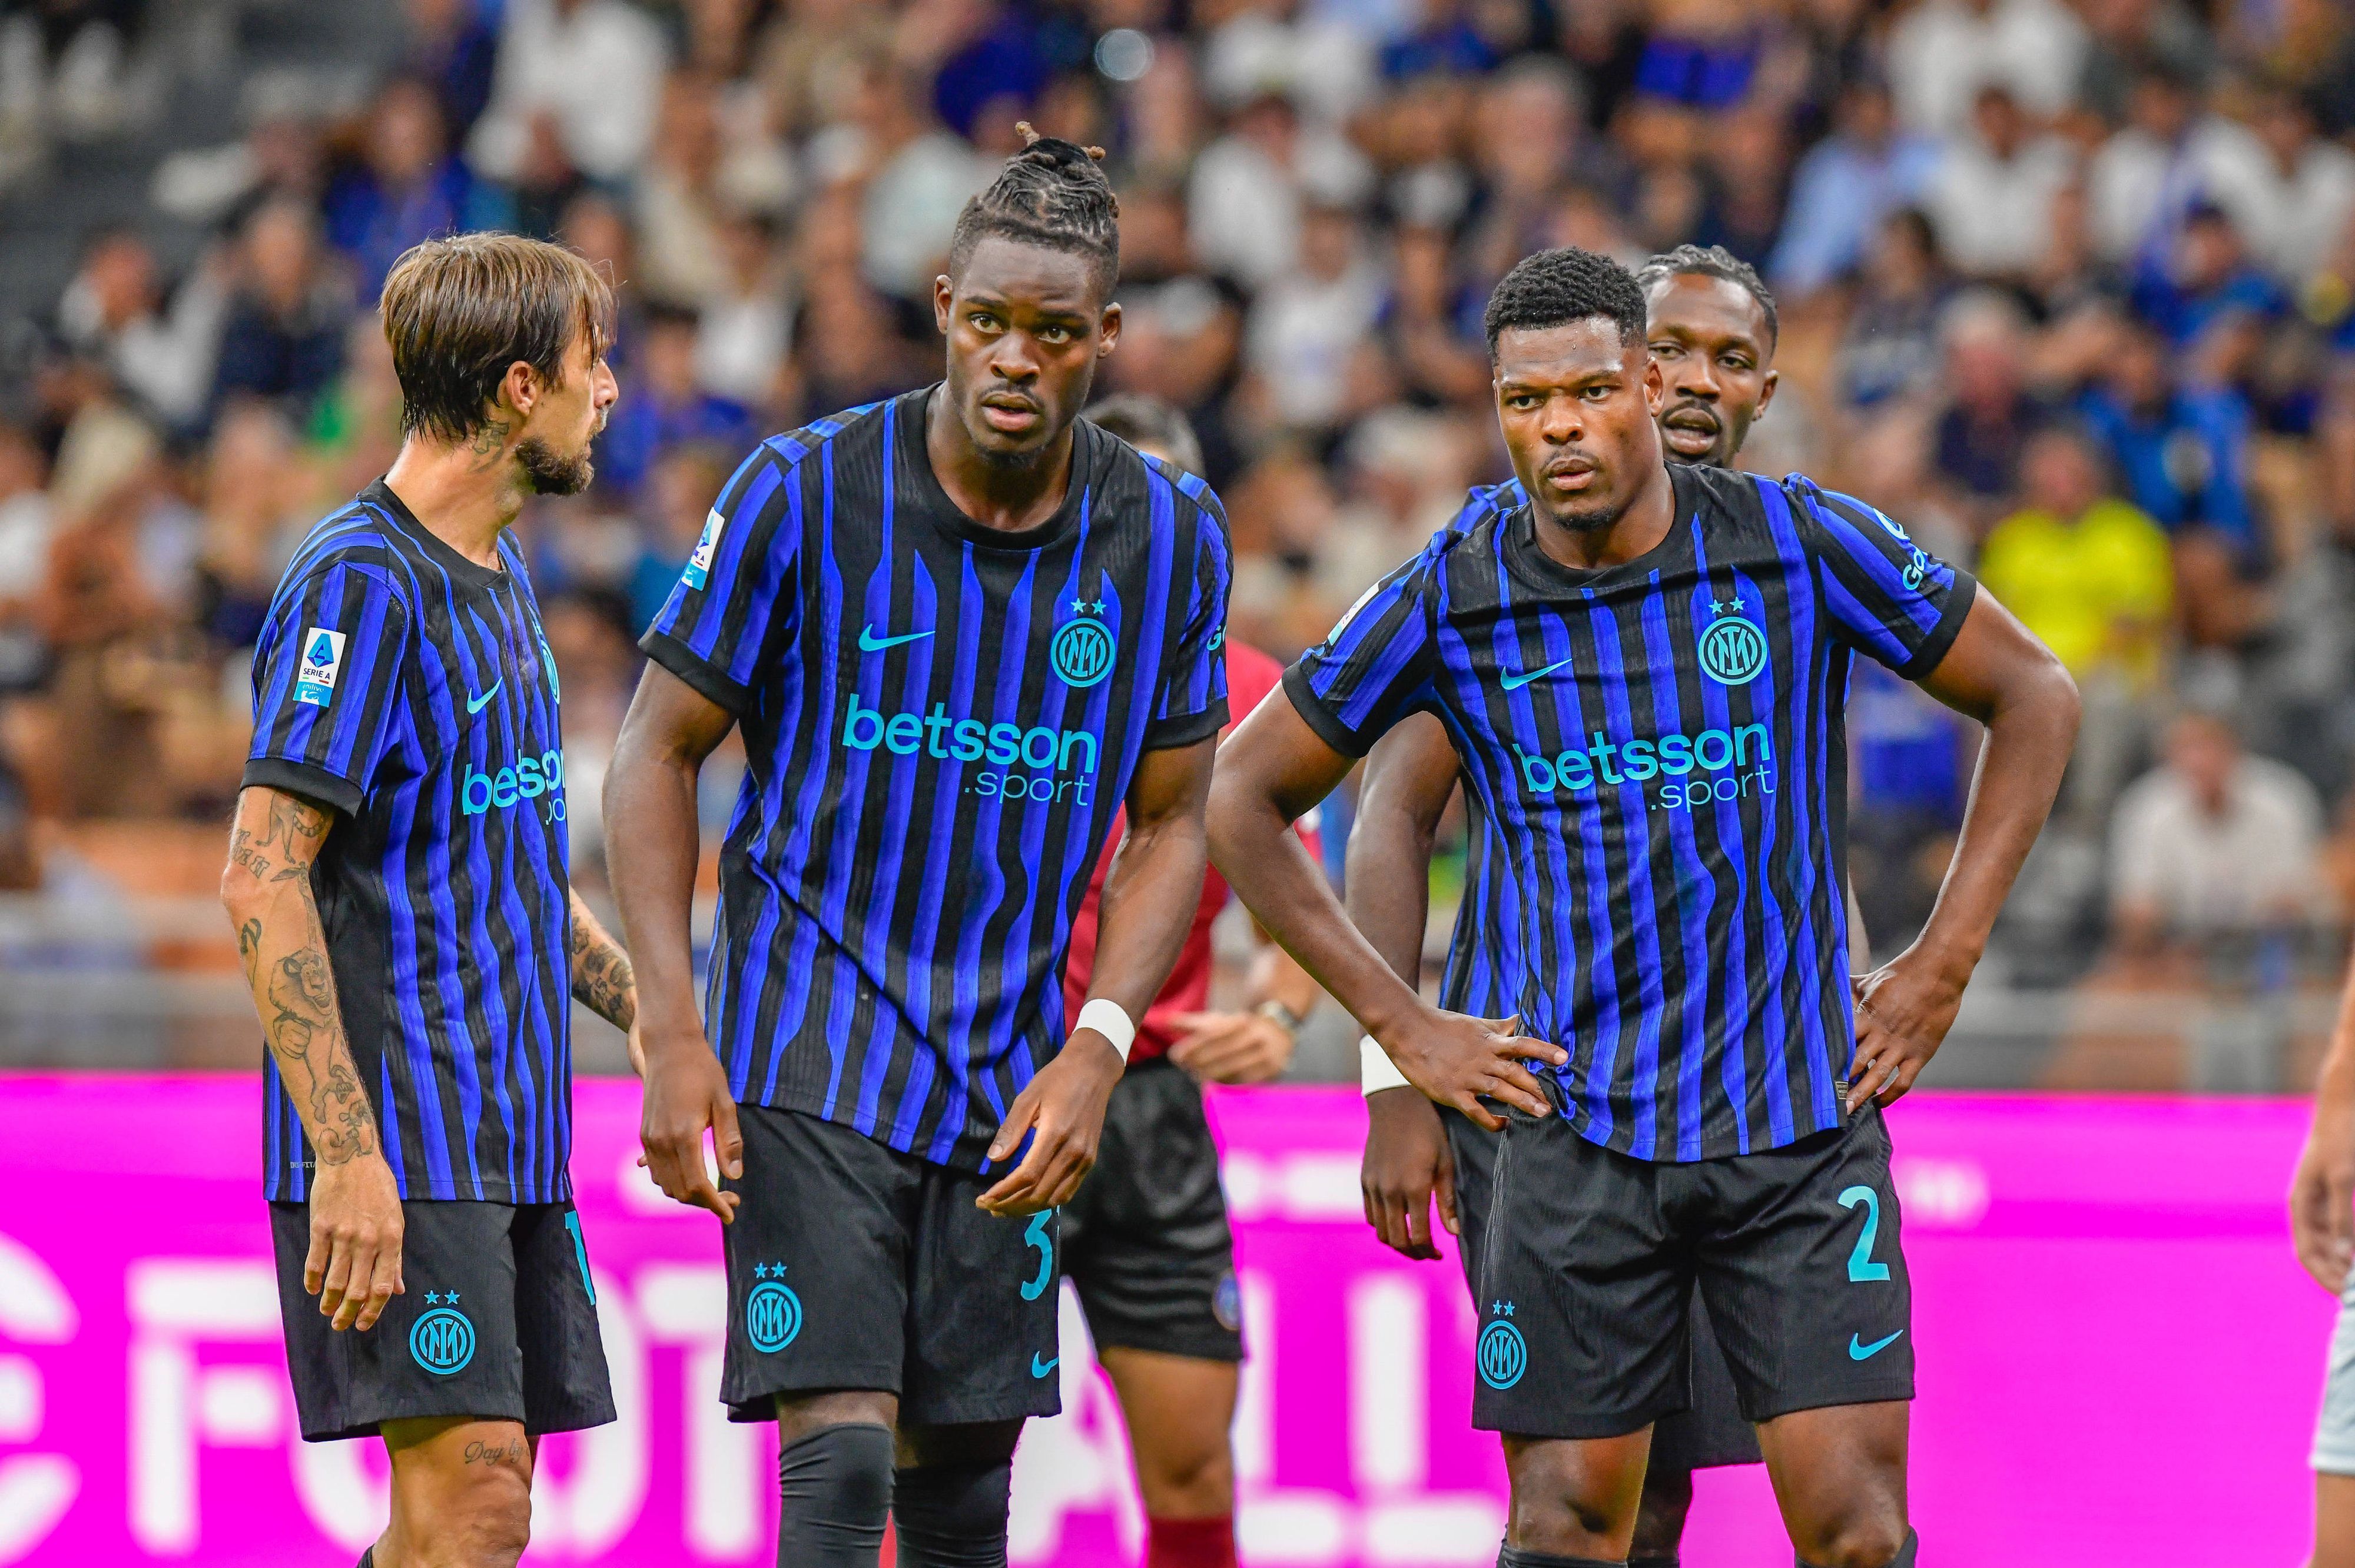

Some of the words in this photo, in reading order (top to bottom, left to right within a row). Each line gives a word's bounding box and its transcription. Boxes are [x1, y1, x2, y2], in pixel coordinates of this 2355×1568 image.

[303, 668, 324, 678] SERIE
[843, 693, 1095, 773] betsson
[1513, 723, 1770, 792] betsson
[964, 772, 1089, 806] .sport
[1651, 765, 1774, 812] .sport
[1021, 1205, 1060, 1300] 3
[1837, 1186, 1890, 1282] 2
[465, 1440, 505, 1466] Day
